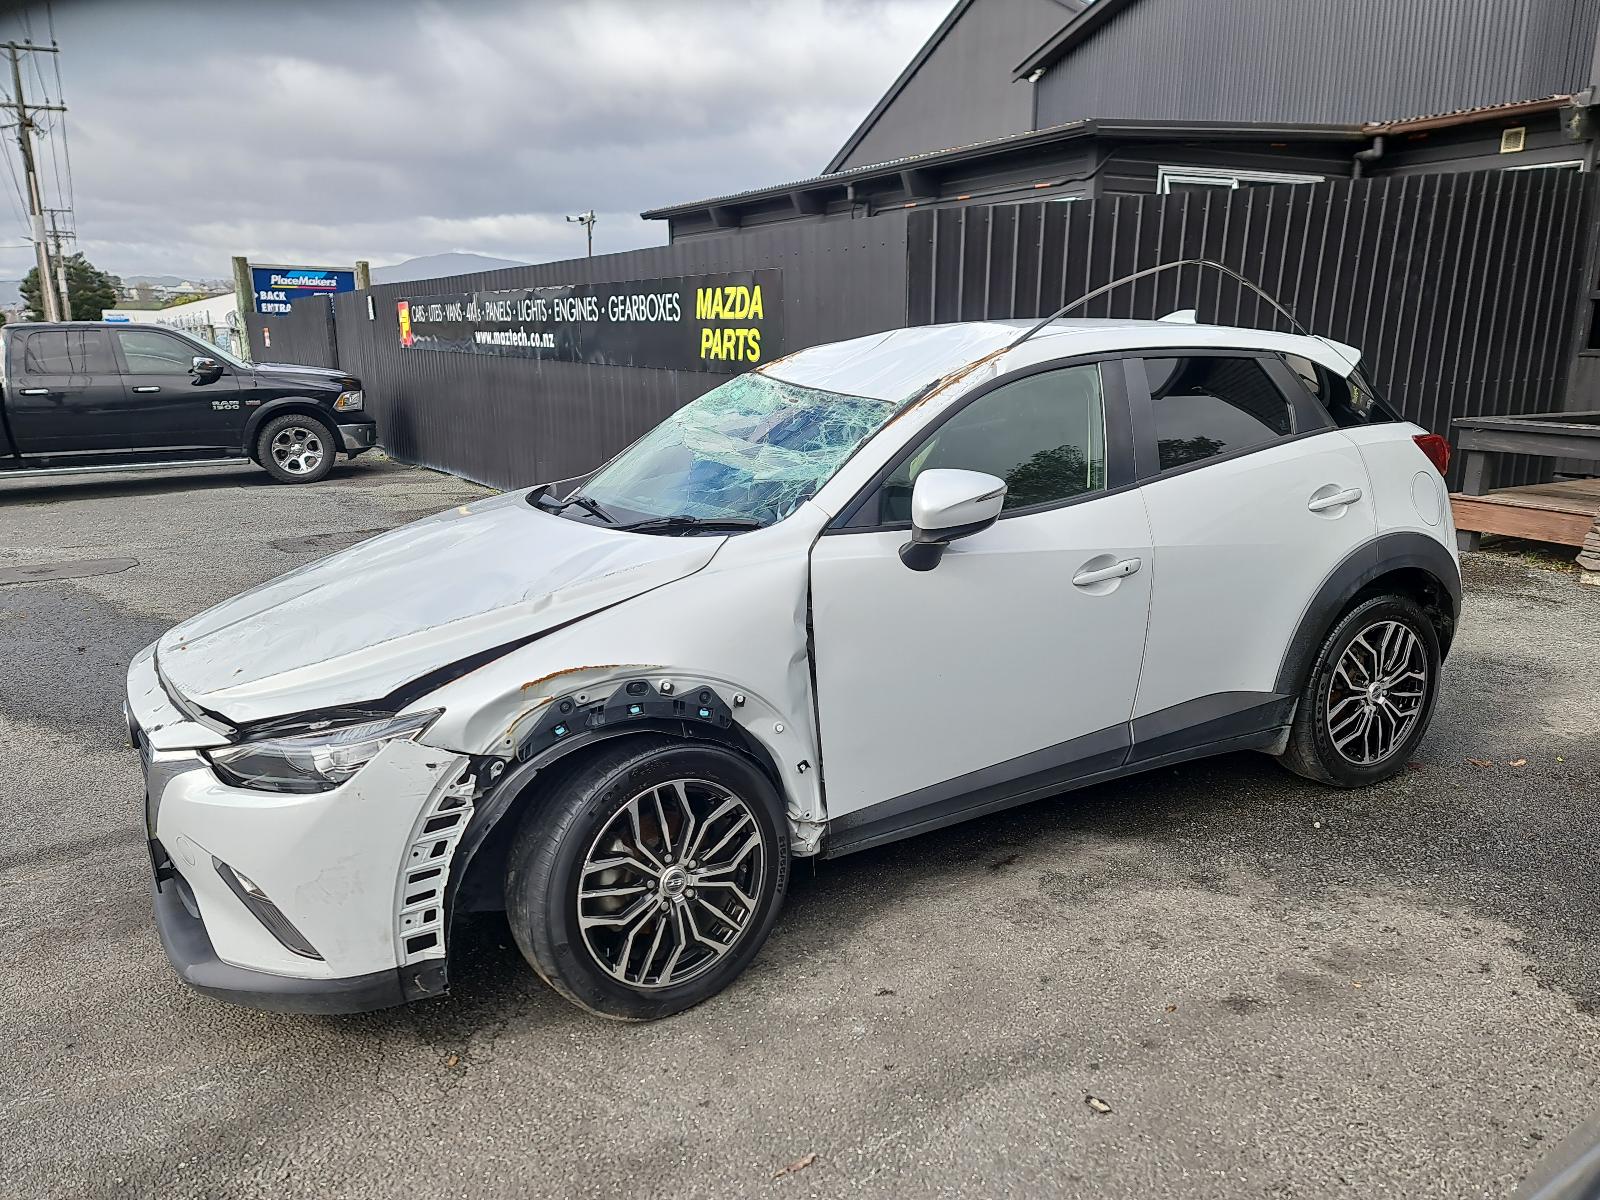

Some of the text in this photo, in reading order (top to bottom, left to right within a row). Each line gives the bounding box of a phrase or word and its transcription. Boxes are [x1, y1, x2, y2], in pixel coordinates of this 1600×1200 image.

[260, 290, 287, 301] BACK
[270, 274, 337, 287] PlaceMakers
[411, 305, 426, 322] CARS
[428, 303, 443, 322] UTES
[445, 302, 463, 322] VANS
[485, 300, 512, 322] PANELS
[517, 298, 548, 322] LIGHTS
[554, 296, 599, 322] ENGINES
[608, 292, 681, 322] GEARBOXES
[695, 284, 764, 320] MAZDA
[700, 327, 761, 363] PARTS
